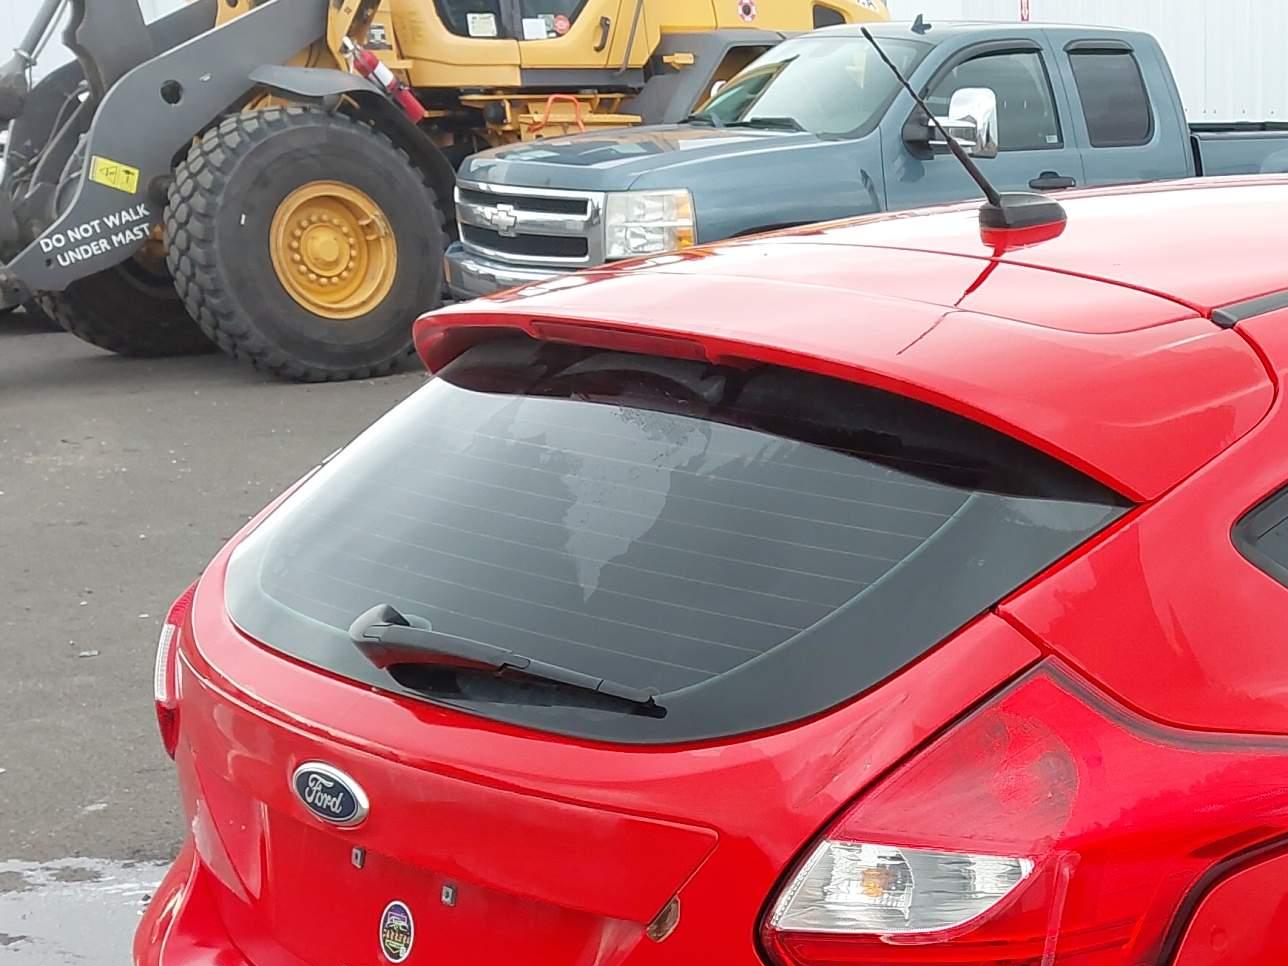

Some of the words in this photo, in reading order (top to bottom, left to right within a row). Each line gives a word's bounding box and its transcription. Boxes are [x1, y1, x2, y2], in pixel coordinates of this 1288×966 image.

[40, 234, 65, 253] DO
[67, 220, 101, 242] NOT
[103, 203, 150, 229] WALK
[57, 238, 111, 266] UNDER
[111, 223, 150, 247] MAST
[305, 774, 344, 813] Ford
